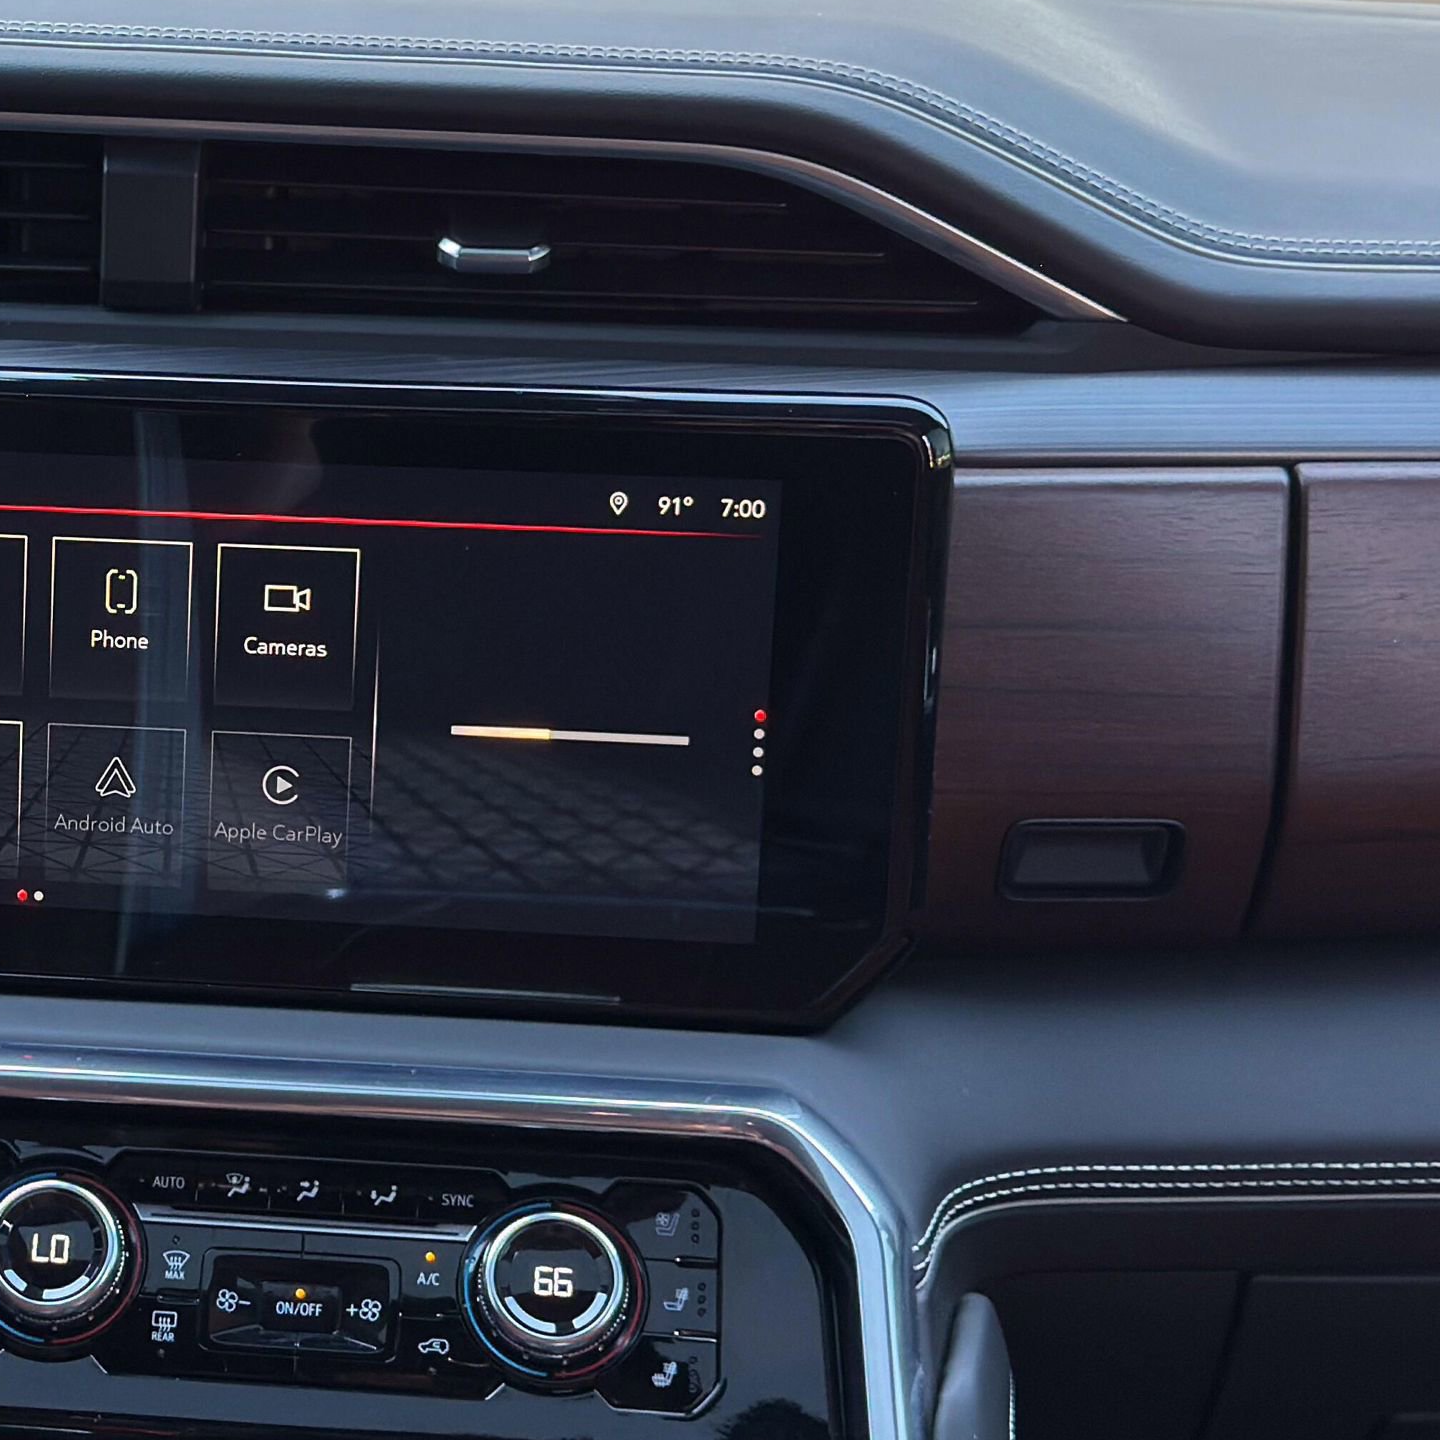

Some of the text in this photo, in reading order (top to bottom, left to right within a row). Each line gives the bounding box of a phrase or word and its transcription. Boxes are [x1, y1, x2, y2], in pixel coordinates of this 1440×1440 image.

[658, 496, 766, 519] 91° 7:00
[90, 628, 149, 651] Phone
[243, 635, 328, 659] Cameras
[54, 813, 174, 837] Android Auto
[214, 822, 343, 848] Apple CarPlay
[152, 1176, 185, 1189] AUTO
[441, 1193, 474, 1208] SYNC
[31, 1232, 70, 1264] LO
[164, 1270, 186, 1280] MAX
[416, 1272, 440, 1286] A/C
[533, 1265, 574, 1298] 66
[276, 1301, 322, 1317] ON/OFF
[151, 1331, 175, 1342] REAR
